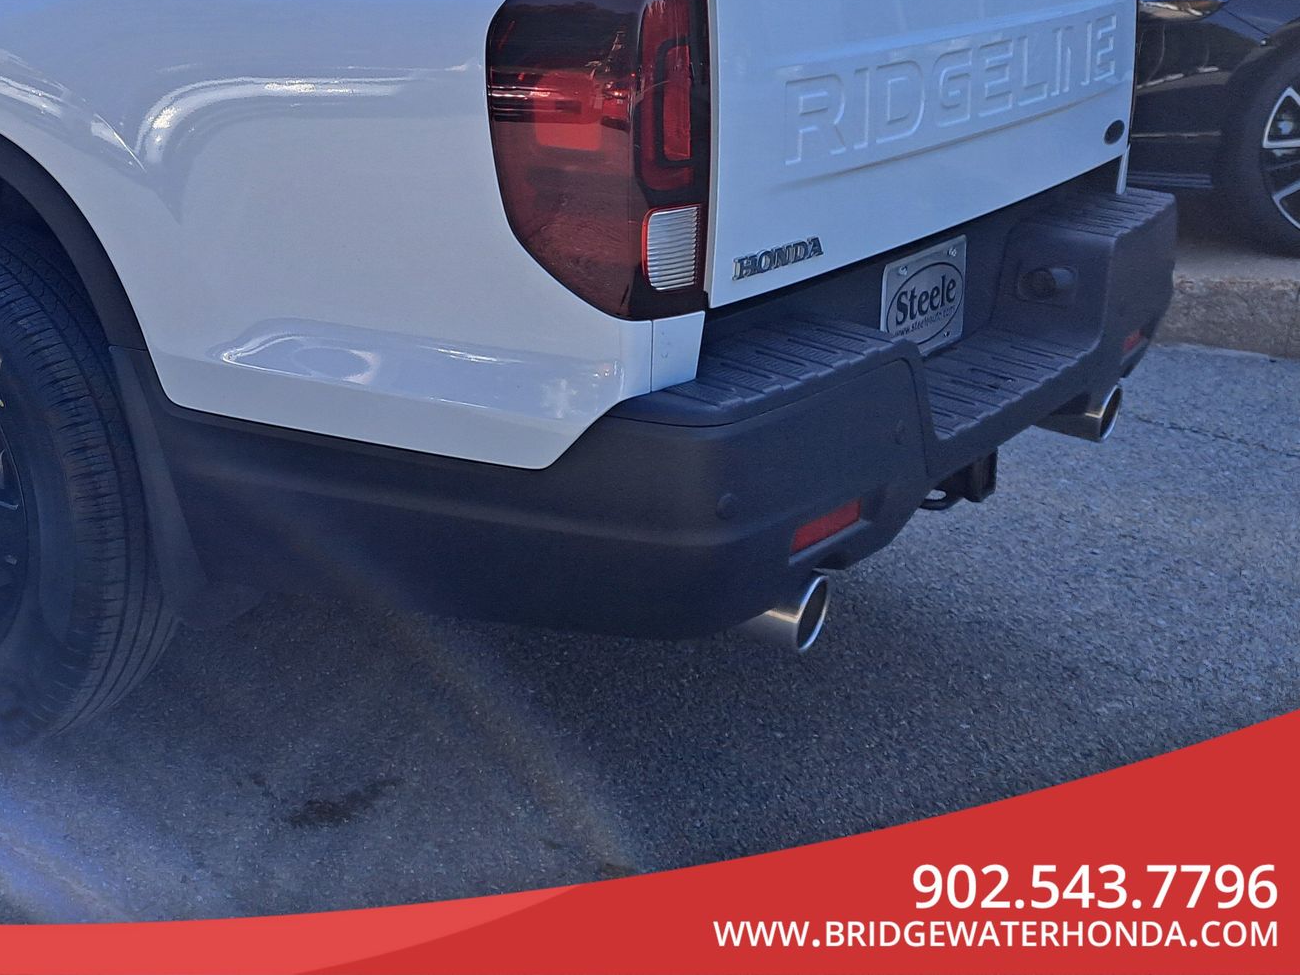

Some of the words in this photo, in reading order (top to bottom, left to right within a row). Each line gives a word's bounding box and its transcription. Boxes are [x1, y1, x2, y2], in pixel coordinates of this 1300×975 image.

[785, 13, 1117, 166] RIDGELINE
[732, 236, 824, 281] HONDA
[895, 274, 957, 326] Steele
